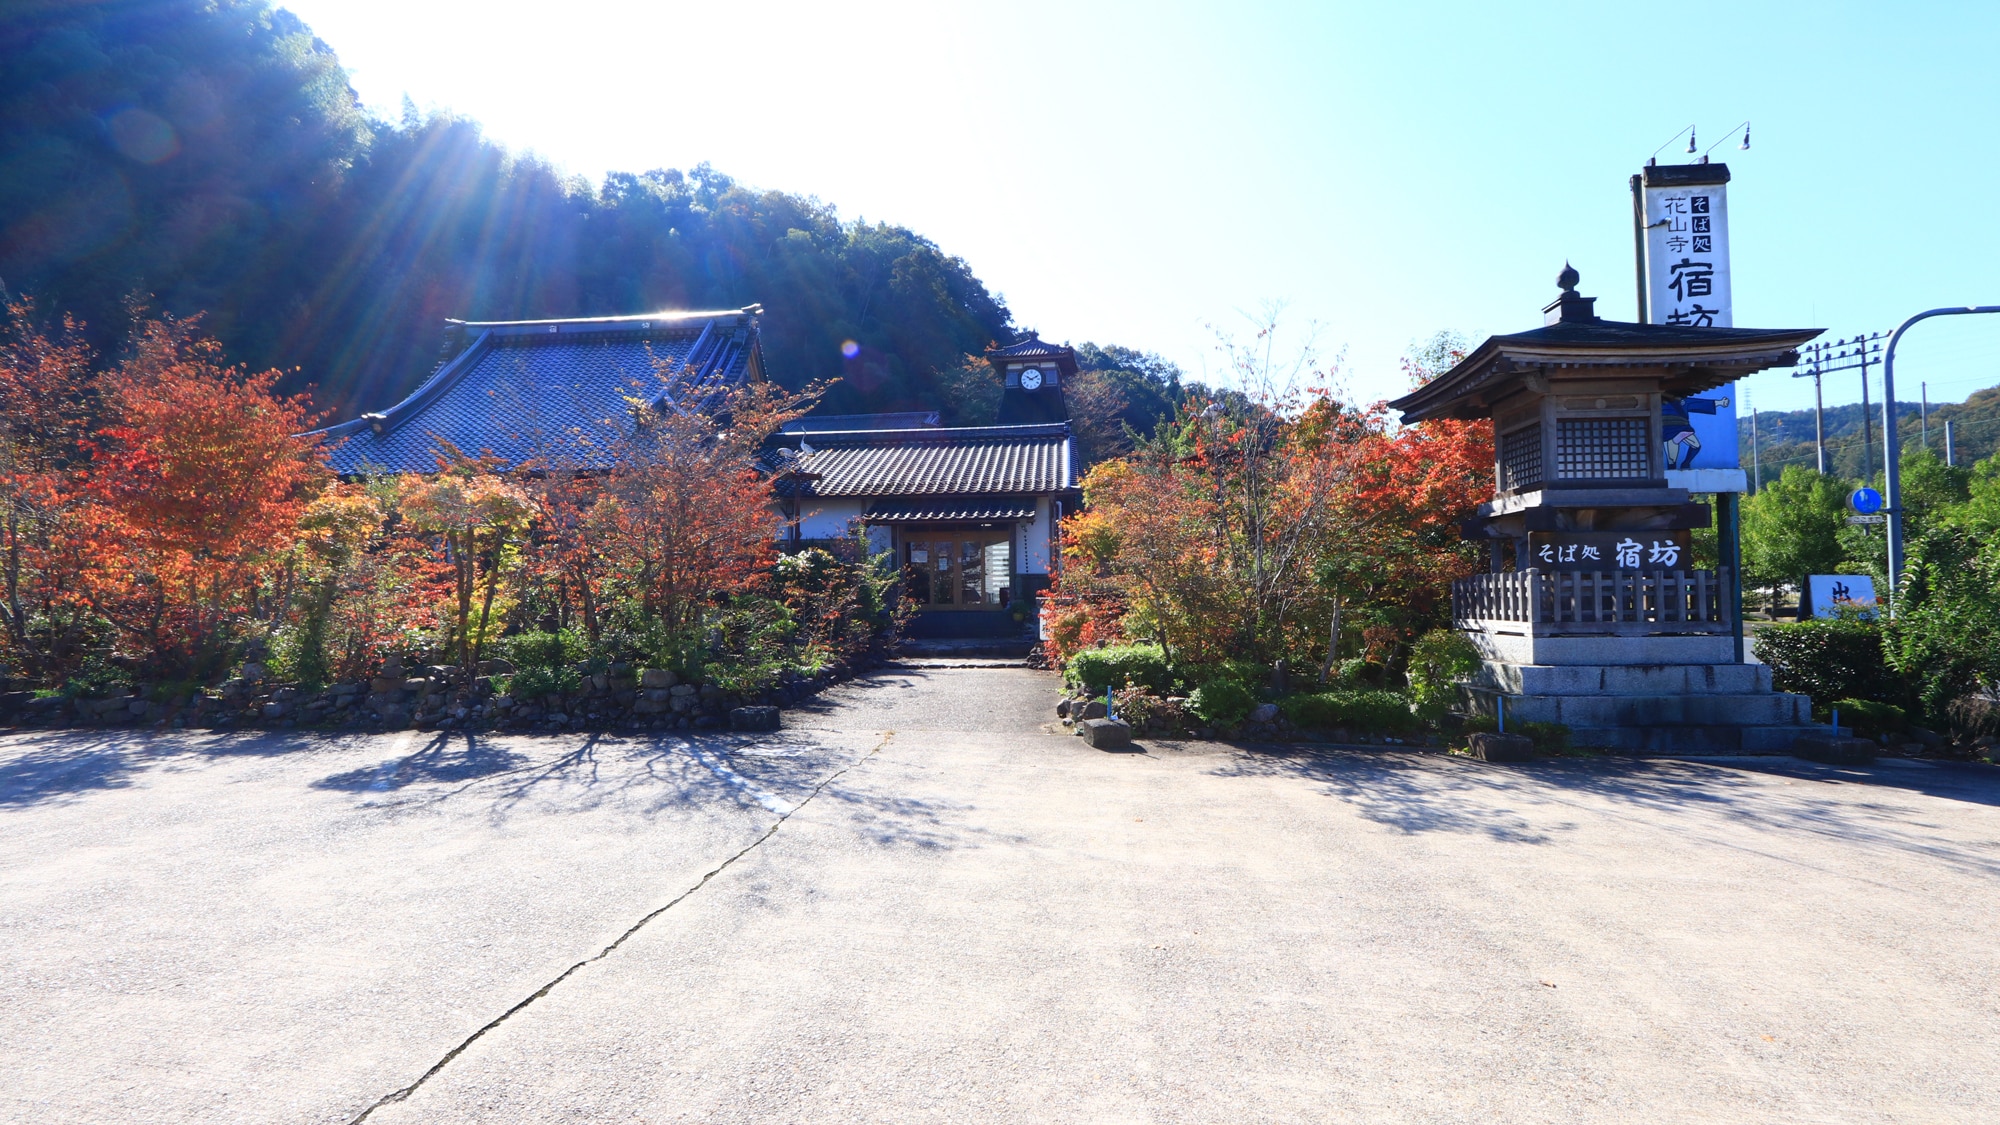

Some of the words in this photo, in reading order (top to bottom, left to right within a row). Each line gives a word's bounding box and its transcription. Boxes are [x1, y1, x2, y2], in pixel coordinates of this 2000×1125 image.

[1664, 197, 1689, 253] 花山寺
[1691, 196, 1711, 252] そば処
[1538, 543, 1601, 563] そば処
[1615, 537, 1681, 569] 宿坊
